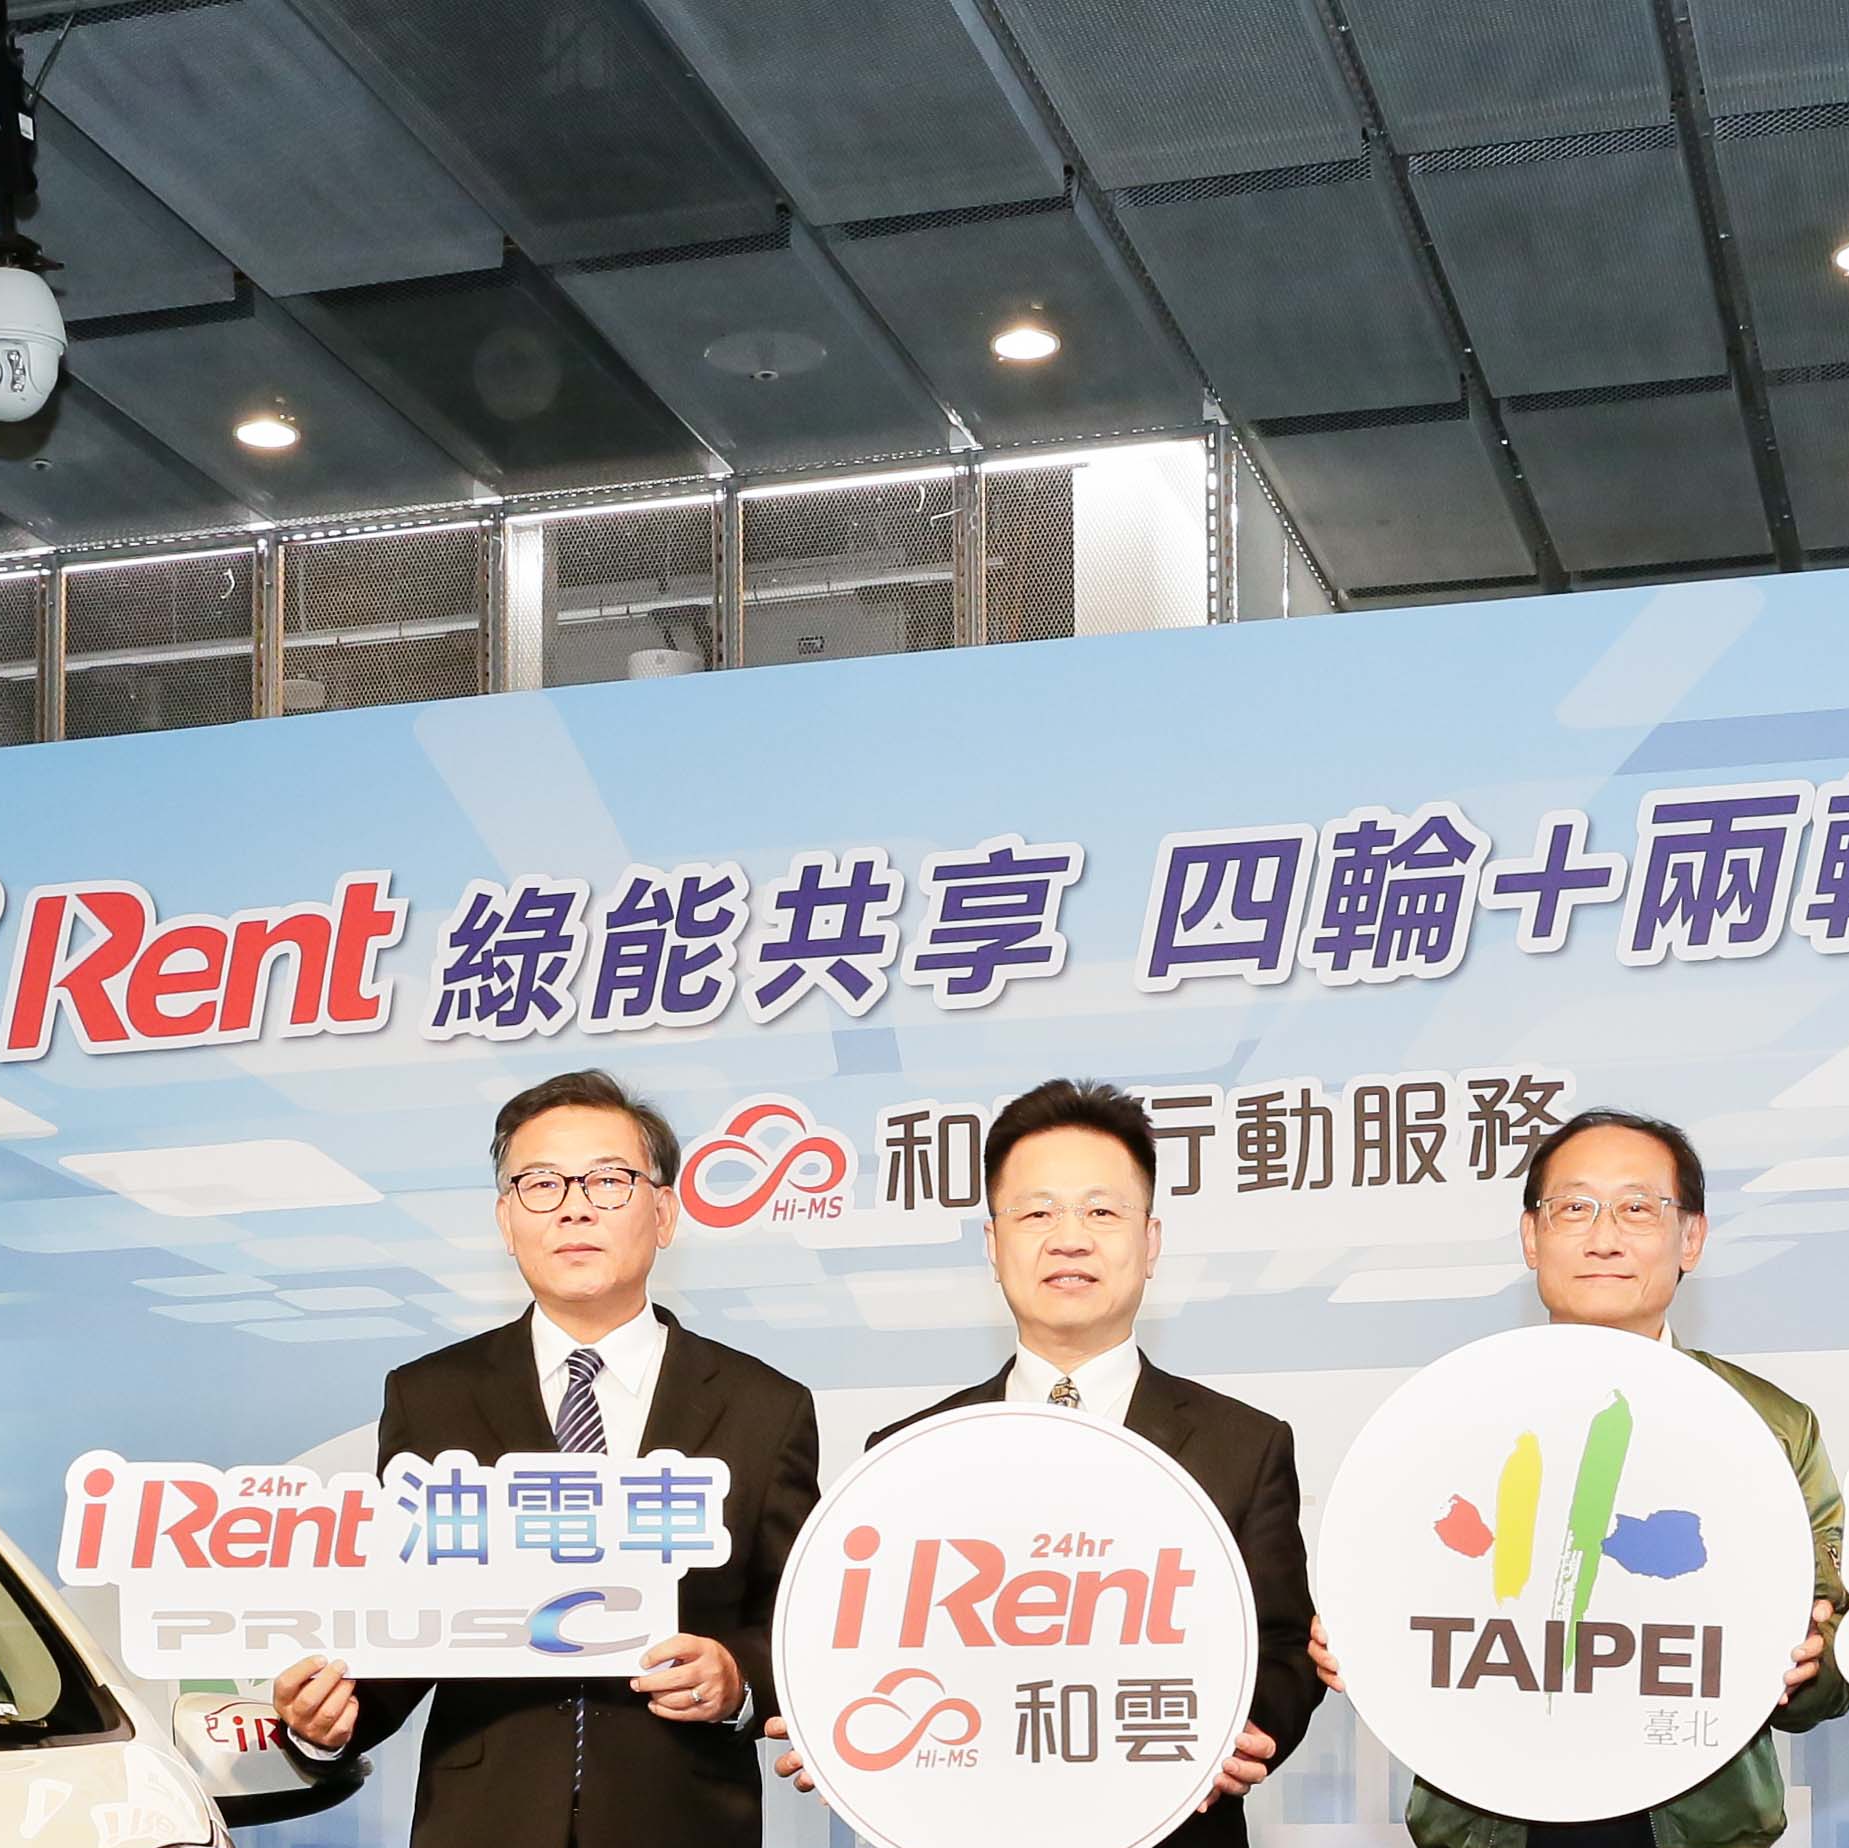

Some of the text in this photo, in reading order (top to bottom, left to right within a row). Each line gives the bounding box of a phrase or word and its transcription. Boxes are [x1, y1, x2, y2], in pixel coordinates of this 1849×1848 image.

[437, 847, 1068, 1027] 綠能共享
[885, 1074, 1566, 1212] 和行動服務
[772, 1197, 844, 1222] Hi-MS
[74, 1468, 714, 1570] iRent 油電車
[238, 1477, 308, 1498] 24hr
[1030, 1533, 1115, 1558] 24hr
[832, 1525, 1197, 1650] iRent
[1410, 1616, 1724, 1698] TAIPEI
[915, 1748, 979, 1768] Hi-MS
[1014, 1677, 1198, 1764] 和雲
[1642, 1708, 1720, 1748] 臺北
